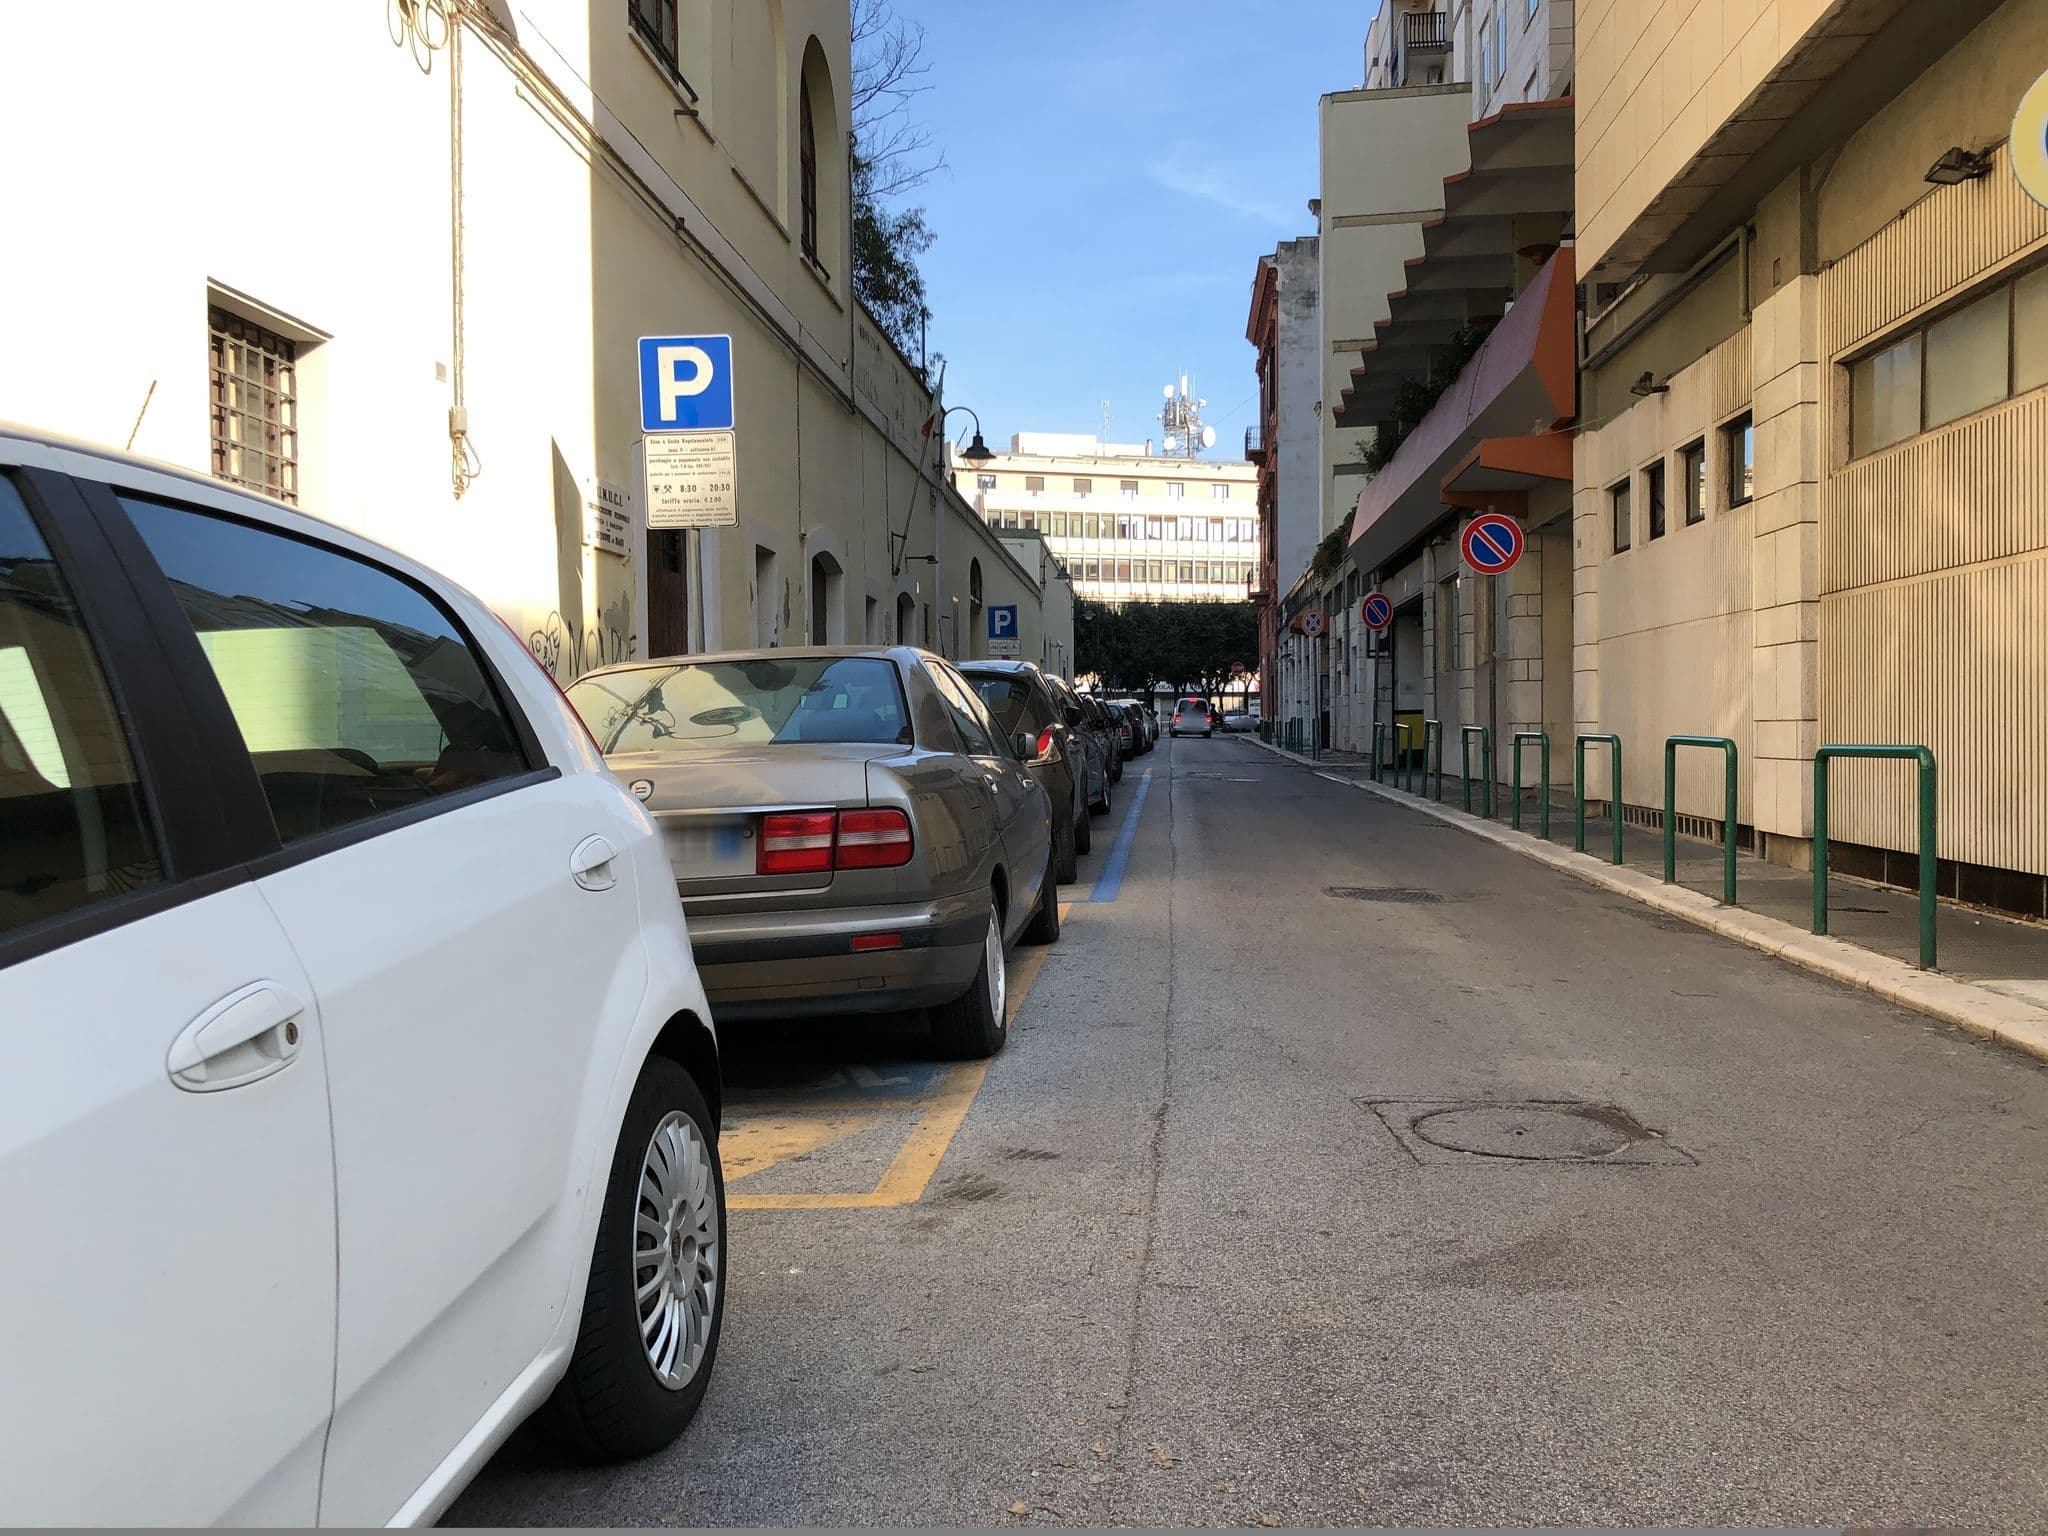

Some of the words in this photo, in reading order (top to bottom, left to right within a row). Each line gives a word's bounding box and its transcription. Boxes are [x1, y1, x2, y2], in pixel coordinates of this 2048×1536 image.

[657, 346, 714, 421] P
[680, 484, 697, 492] 8:30
[995, 610, 1011, 634] P
